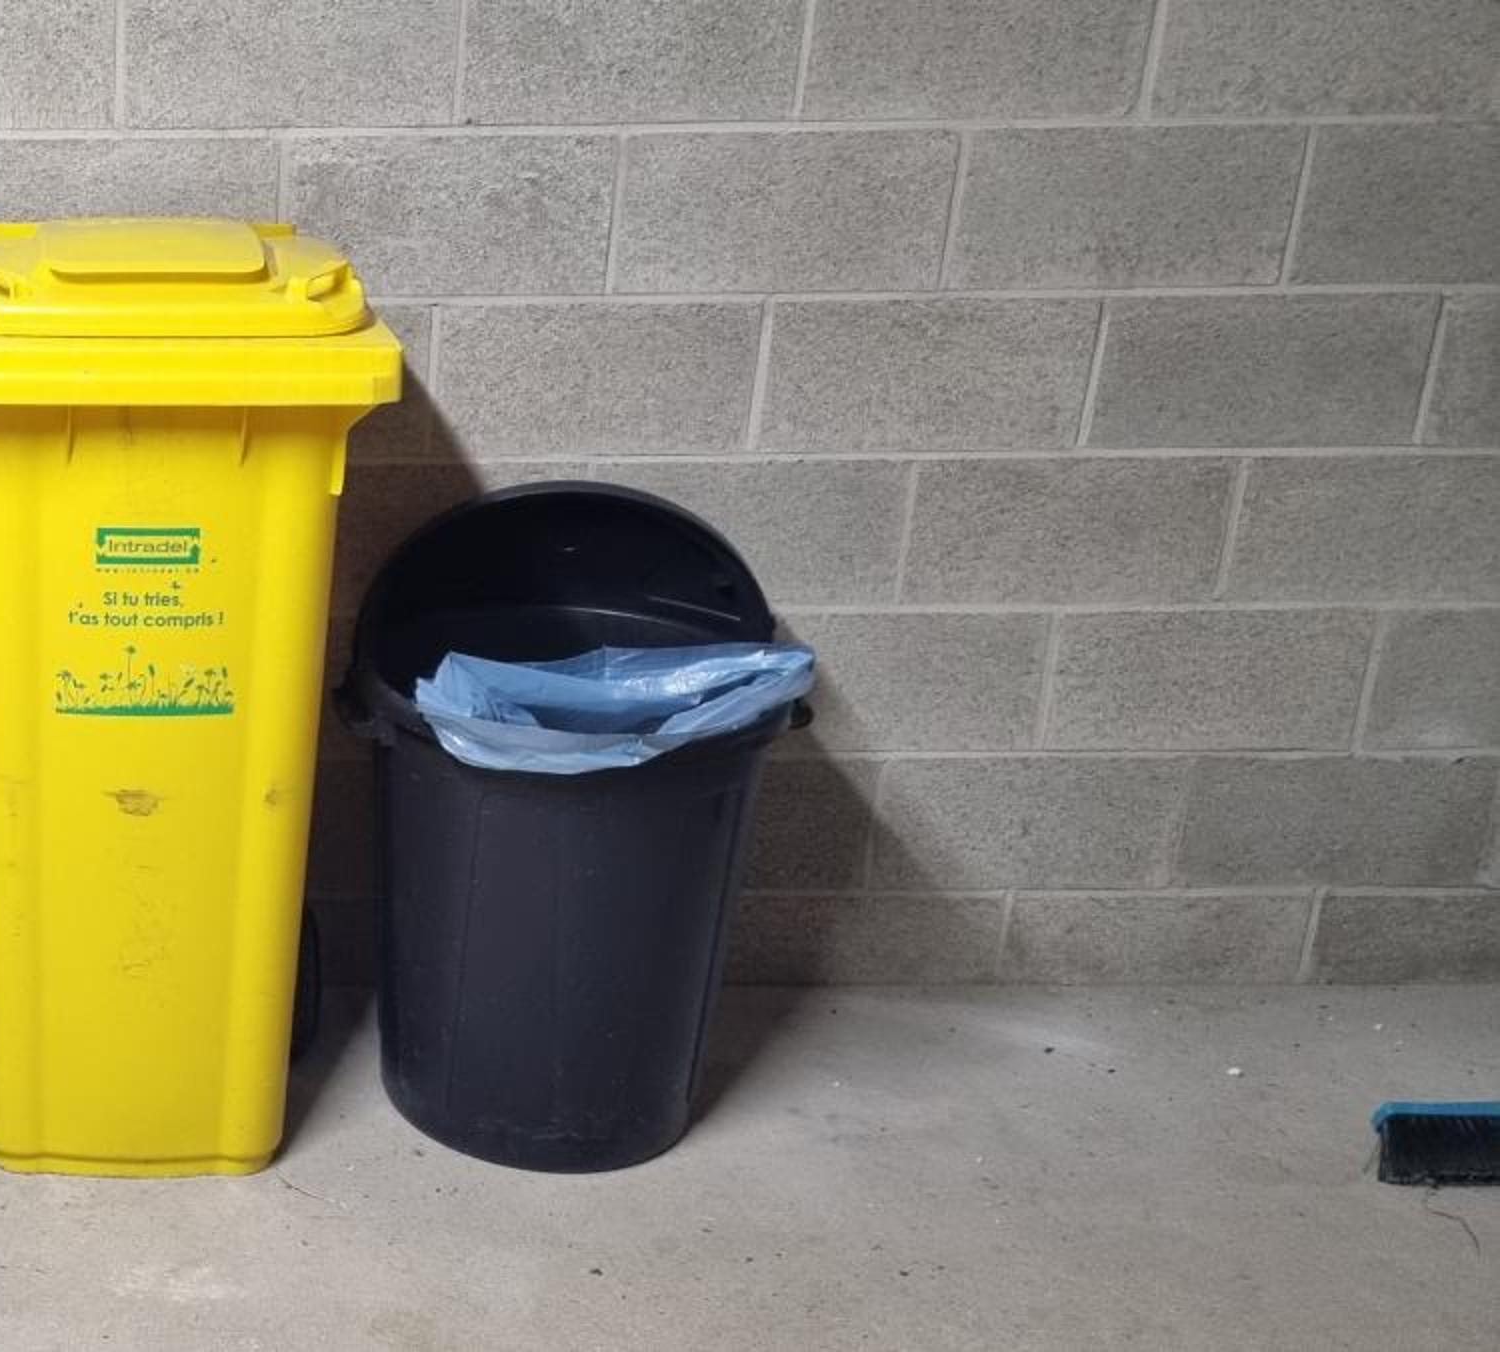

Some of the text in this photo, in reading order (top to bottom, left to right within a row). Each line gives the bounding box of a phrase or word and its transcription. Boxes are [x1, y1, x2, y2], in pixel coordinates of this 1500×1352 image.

[109, 540, 188, 553] Intradel
[104, 592, 184, 607] Si tu tries,
[69, 612, 99, 625] t'as
[104, 613, 138, 626] tout
[143, 612, 214, 629] compris
